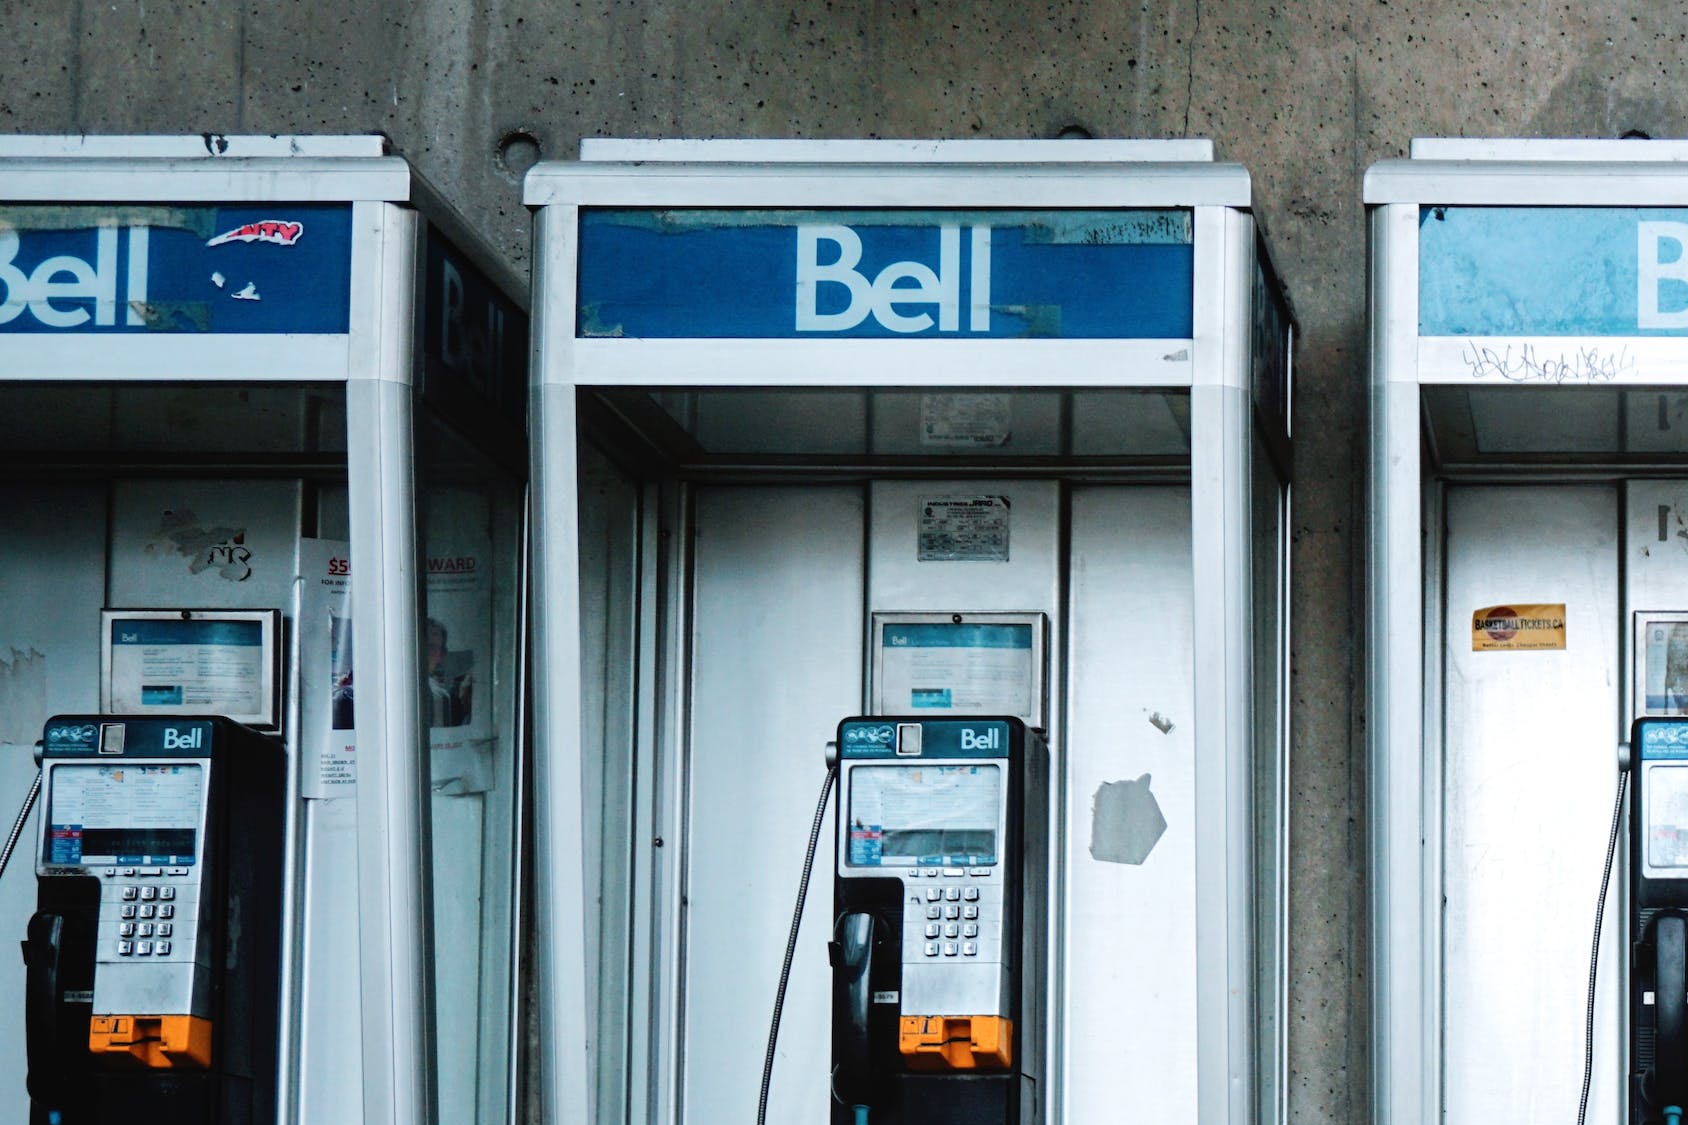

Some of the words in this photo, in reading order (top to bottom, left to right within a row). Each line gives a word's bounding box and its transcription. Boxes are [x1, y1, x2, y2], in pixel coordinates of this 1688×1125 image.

[229, 222, 300, 241] NTY
[795, 224, 991, 332] Bell
[329, 556, 351, 574] $5
[892, 636, 907, 645] Bell
[163, 727, 203, 749] Bell
[961, 727, 999, 750] Bell
